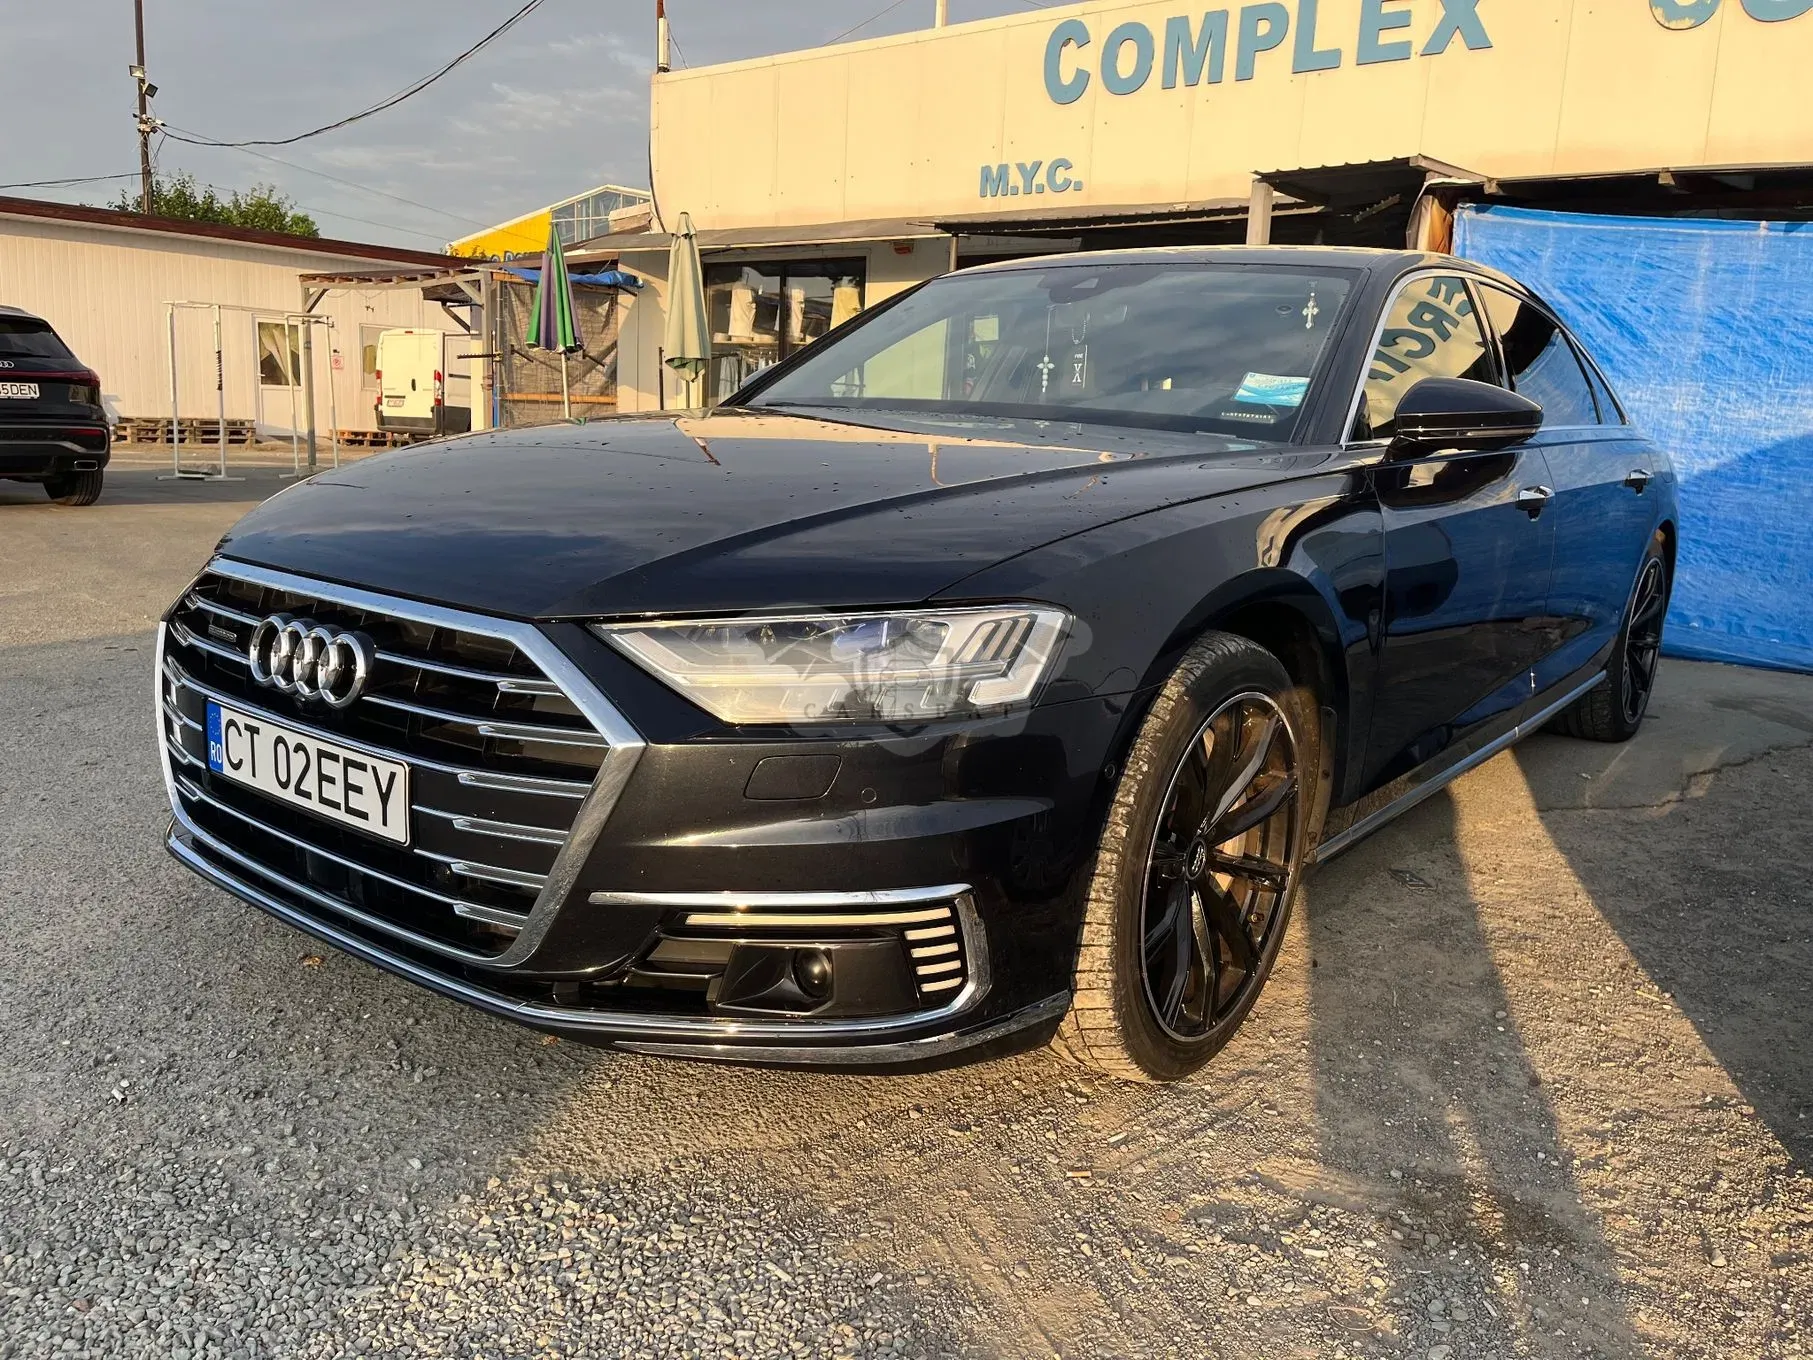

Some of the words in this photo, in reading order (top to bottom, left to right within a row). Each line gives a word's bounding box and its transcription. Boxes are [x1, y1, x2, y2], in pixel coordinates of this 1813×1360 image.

[1044, 0, 1493, 104] COMPLEX
[980, 158, 1083, 197] M.Y.C.
[0, 384, 37, 396] 5DEN
[210, 741, 223, 764] RO
[225, 718, 260, 778] CT
